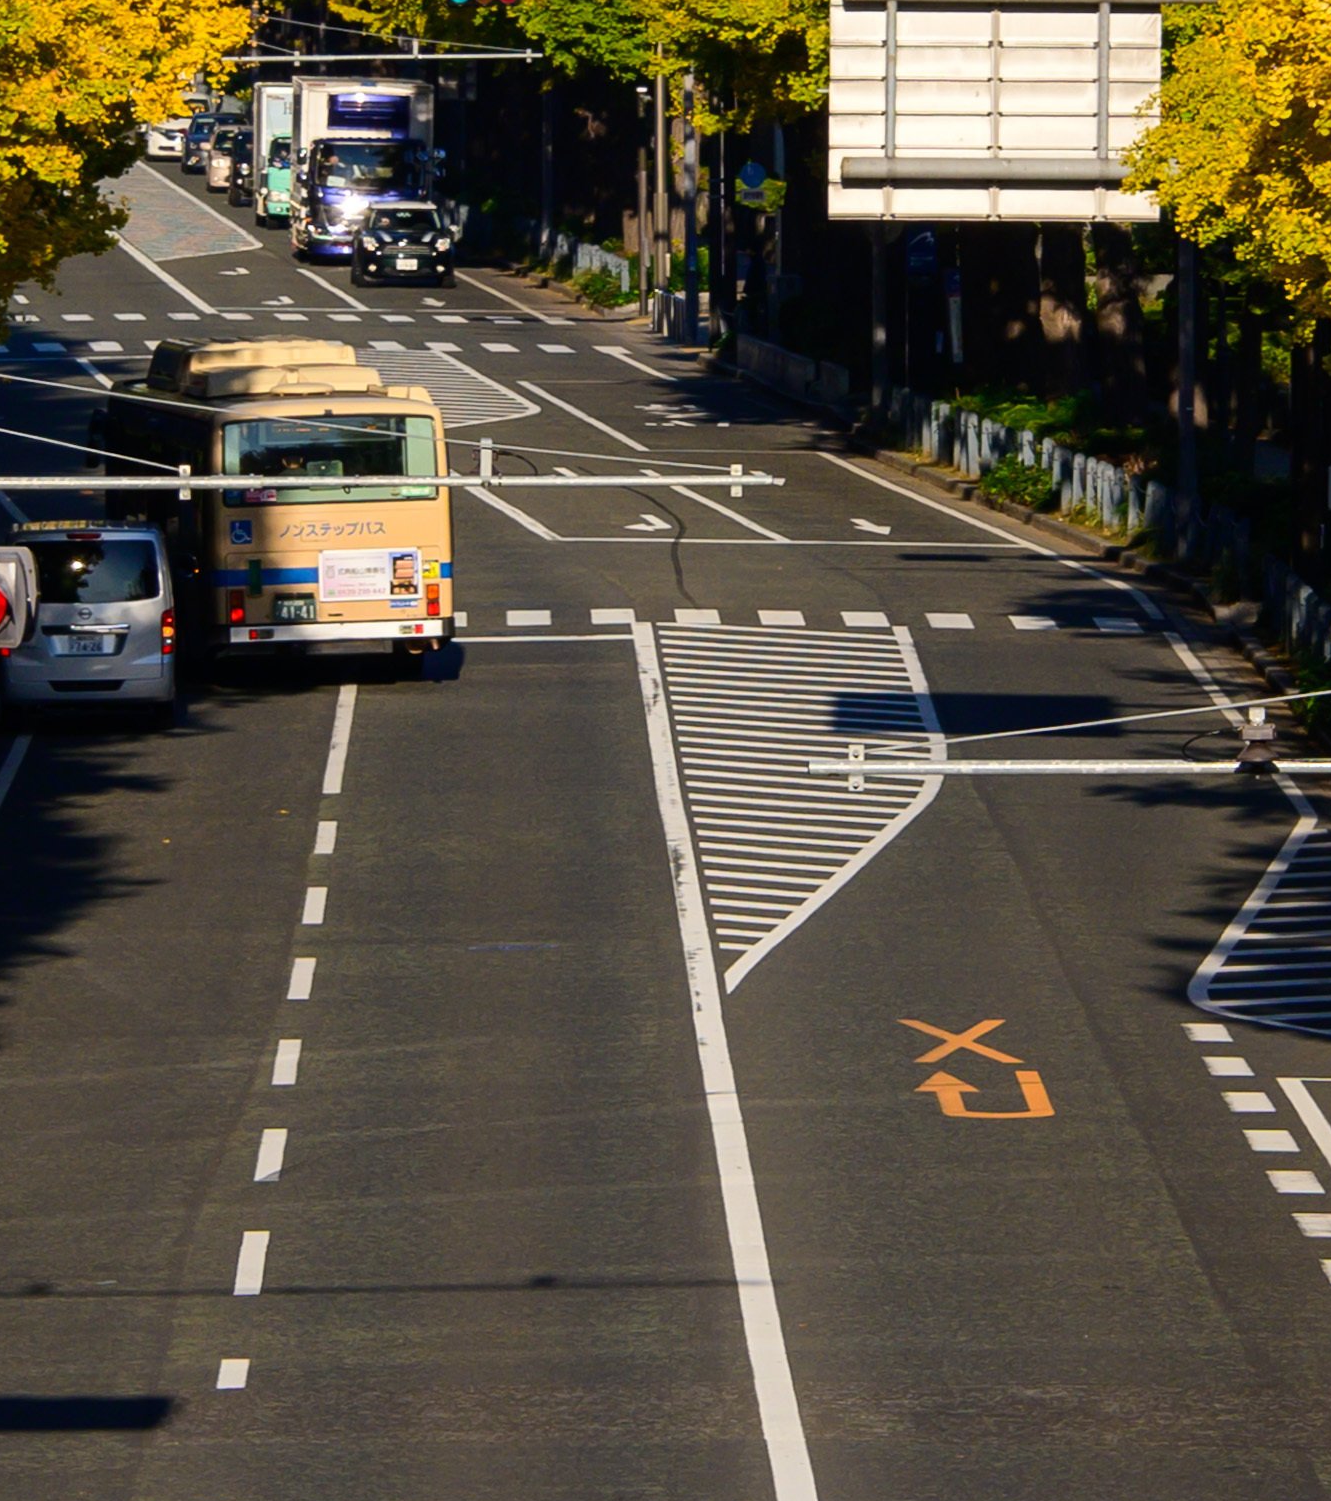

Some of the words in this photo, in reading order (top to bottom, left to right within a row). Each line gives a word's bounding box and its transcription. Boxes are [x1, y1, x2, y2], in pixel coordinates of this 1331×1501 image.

[279, 521, 387, 538] ノンステップバス
[281, 606, 314, 619] 41-41
